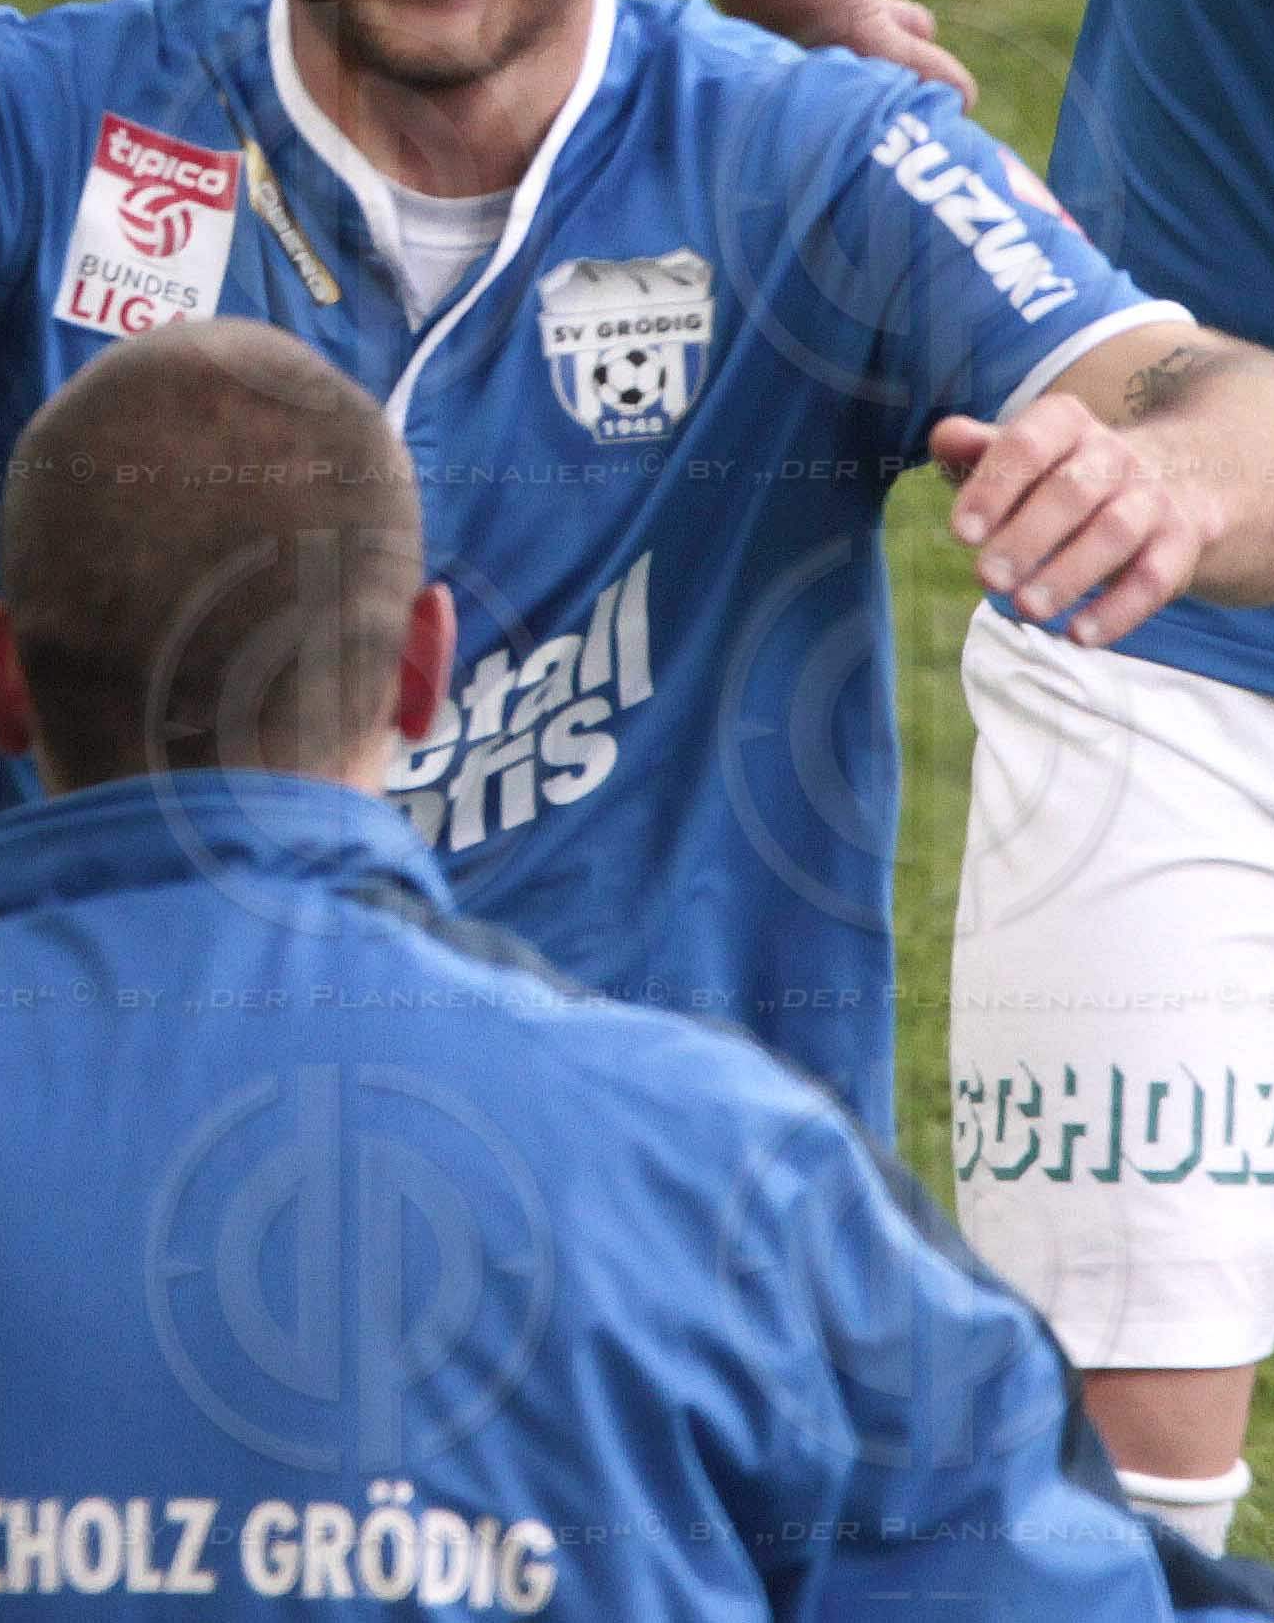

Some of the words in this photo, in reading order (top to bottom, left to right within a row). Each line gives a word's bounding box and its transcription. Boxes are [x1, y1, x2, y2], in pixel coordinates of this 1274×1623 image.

[108, 127, 228, 196] tipico
[871, 112, 1078, 324] SUZUKI
[69, 280, 186, 334] LIG
[78, 254, 198, 308] BUNDES
[240, 1480, 560, 1616] GRÖDIG
